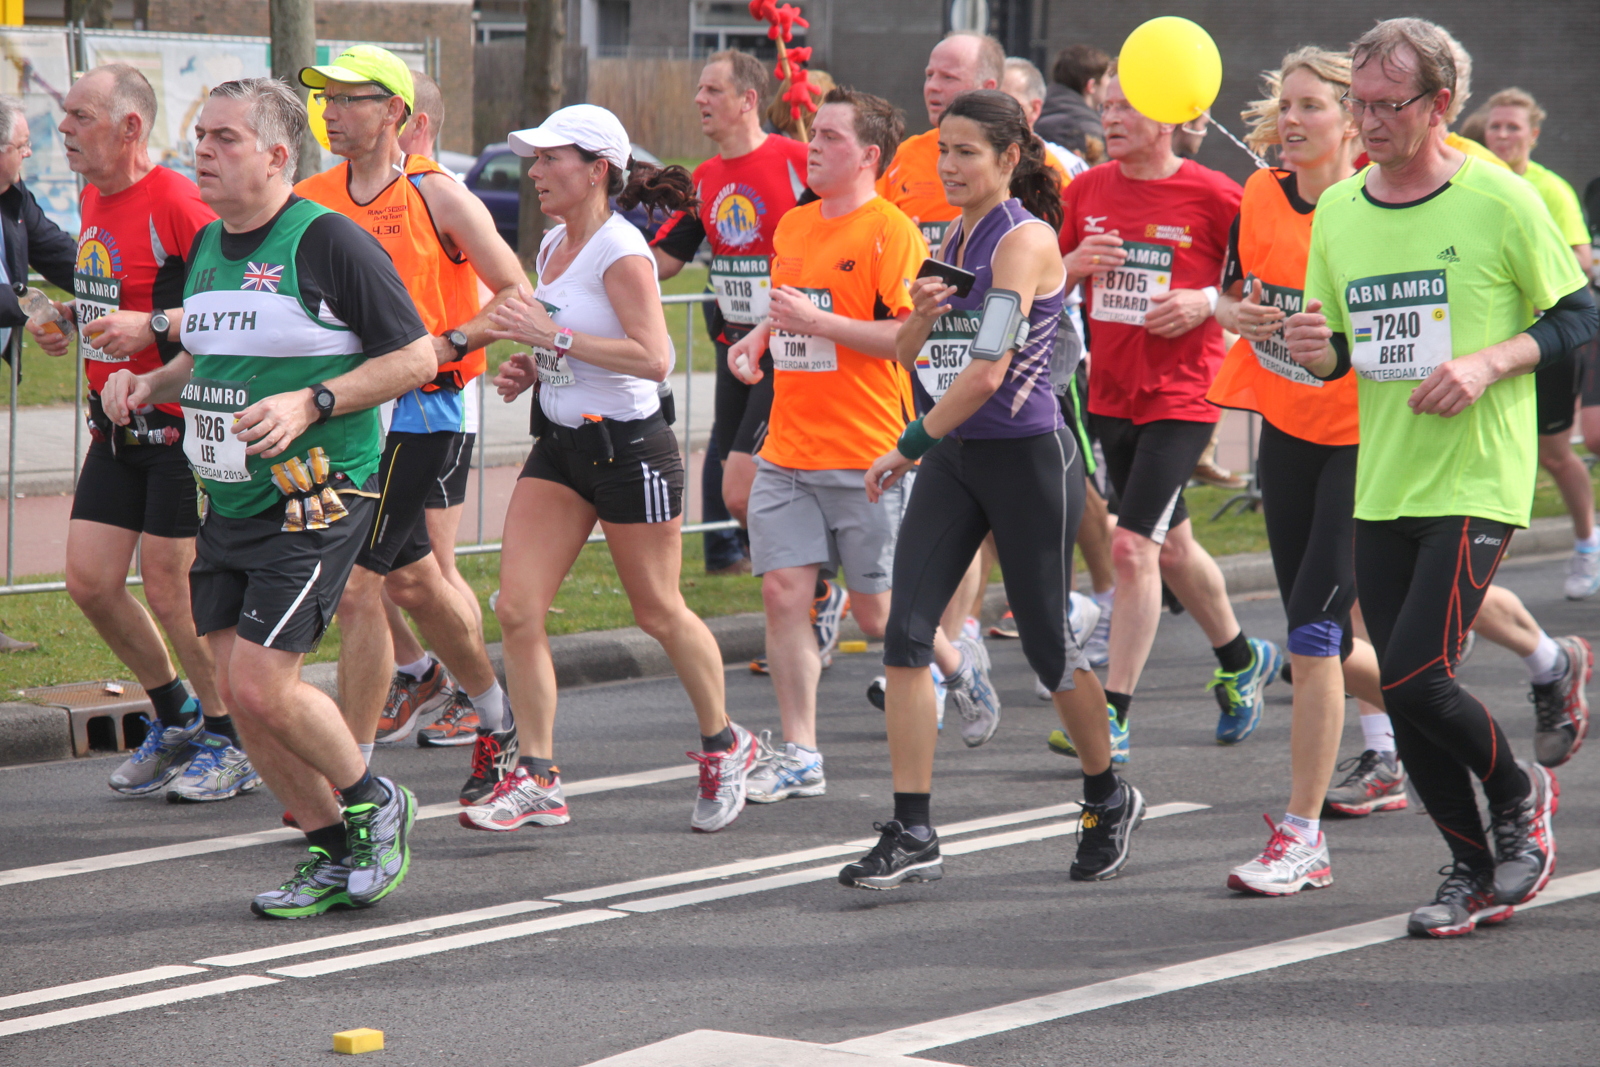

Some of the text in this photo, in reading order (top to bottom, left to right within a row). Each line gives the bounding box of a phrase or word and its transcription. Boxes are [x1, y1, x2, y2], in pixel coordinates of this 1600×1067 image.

[373, 225, 400, 235] 4.30
[921, 226, 940, 241] BN
[98, 227, 122, 273] ZEELAND
[1126, 247, 1171, 267] AMRO
[711, 258, 730, 273] ABN
[732, 259, 767, 274] AMRO
[89, 280, 119, 300] AMRO
[192, 266, 218, 295] LEE
[724, 280, 753, 298] 8718
[1106, 270, 1149, 294] 8705
[809, 293, 831, 308] RO
[1243, 280, 1301, 312] AN AM
[1348, 278, 1445, 305] ABN AMRO
[731, 299, 751, 313] JOHN
[1102, 293, 1148, 312] GERARD
[185, 311, 257, 334] BLYTH
[945, 316, 980, 333] AMRO
[1434, 310, 1443, 319] G
[1372, 311, 1421, 342] 7240
[784, 341, 806, 357] TOM
[930, 344, 968, 370] 9557
[1379, 343, 1415, 364] BERT
[551, 375, 570, 385] 2013
[180, 383, 246, 406] ABN AMRO
[194, 413, 225, 443] 1626
[201, 444, 216, 464] LEE
[223, 470, 244, 480] 2013
